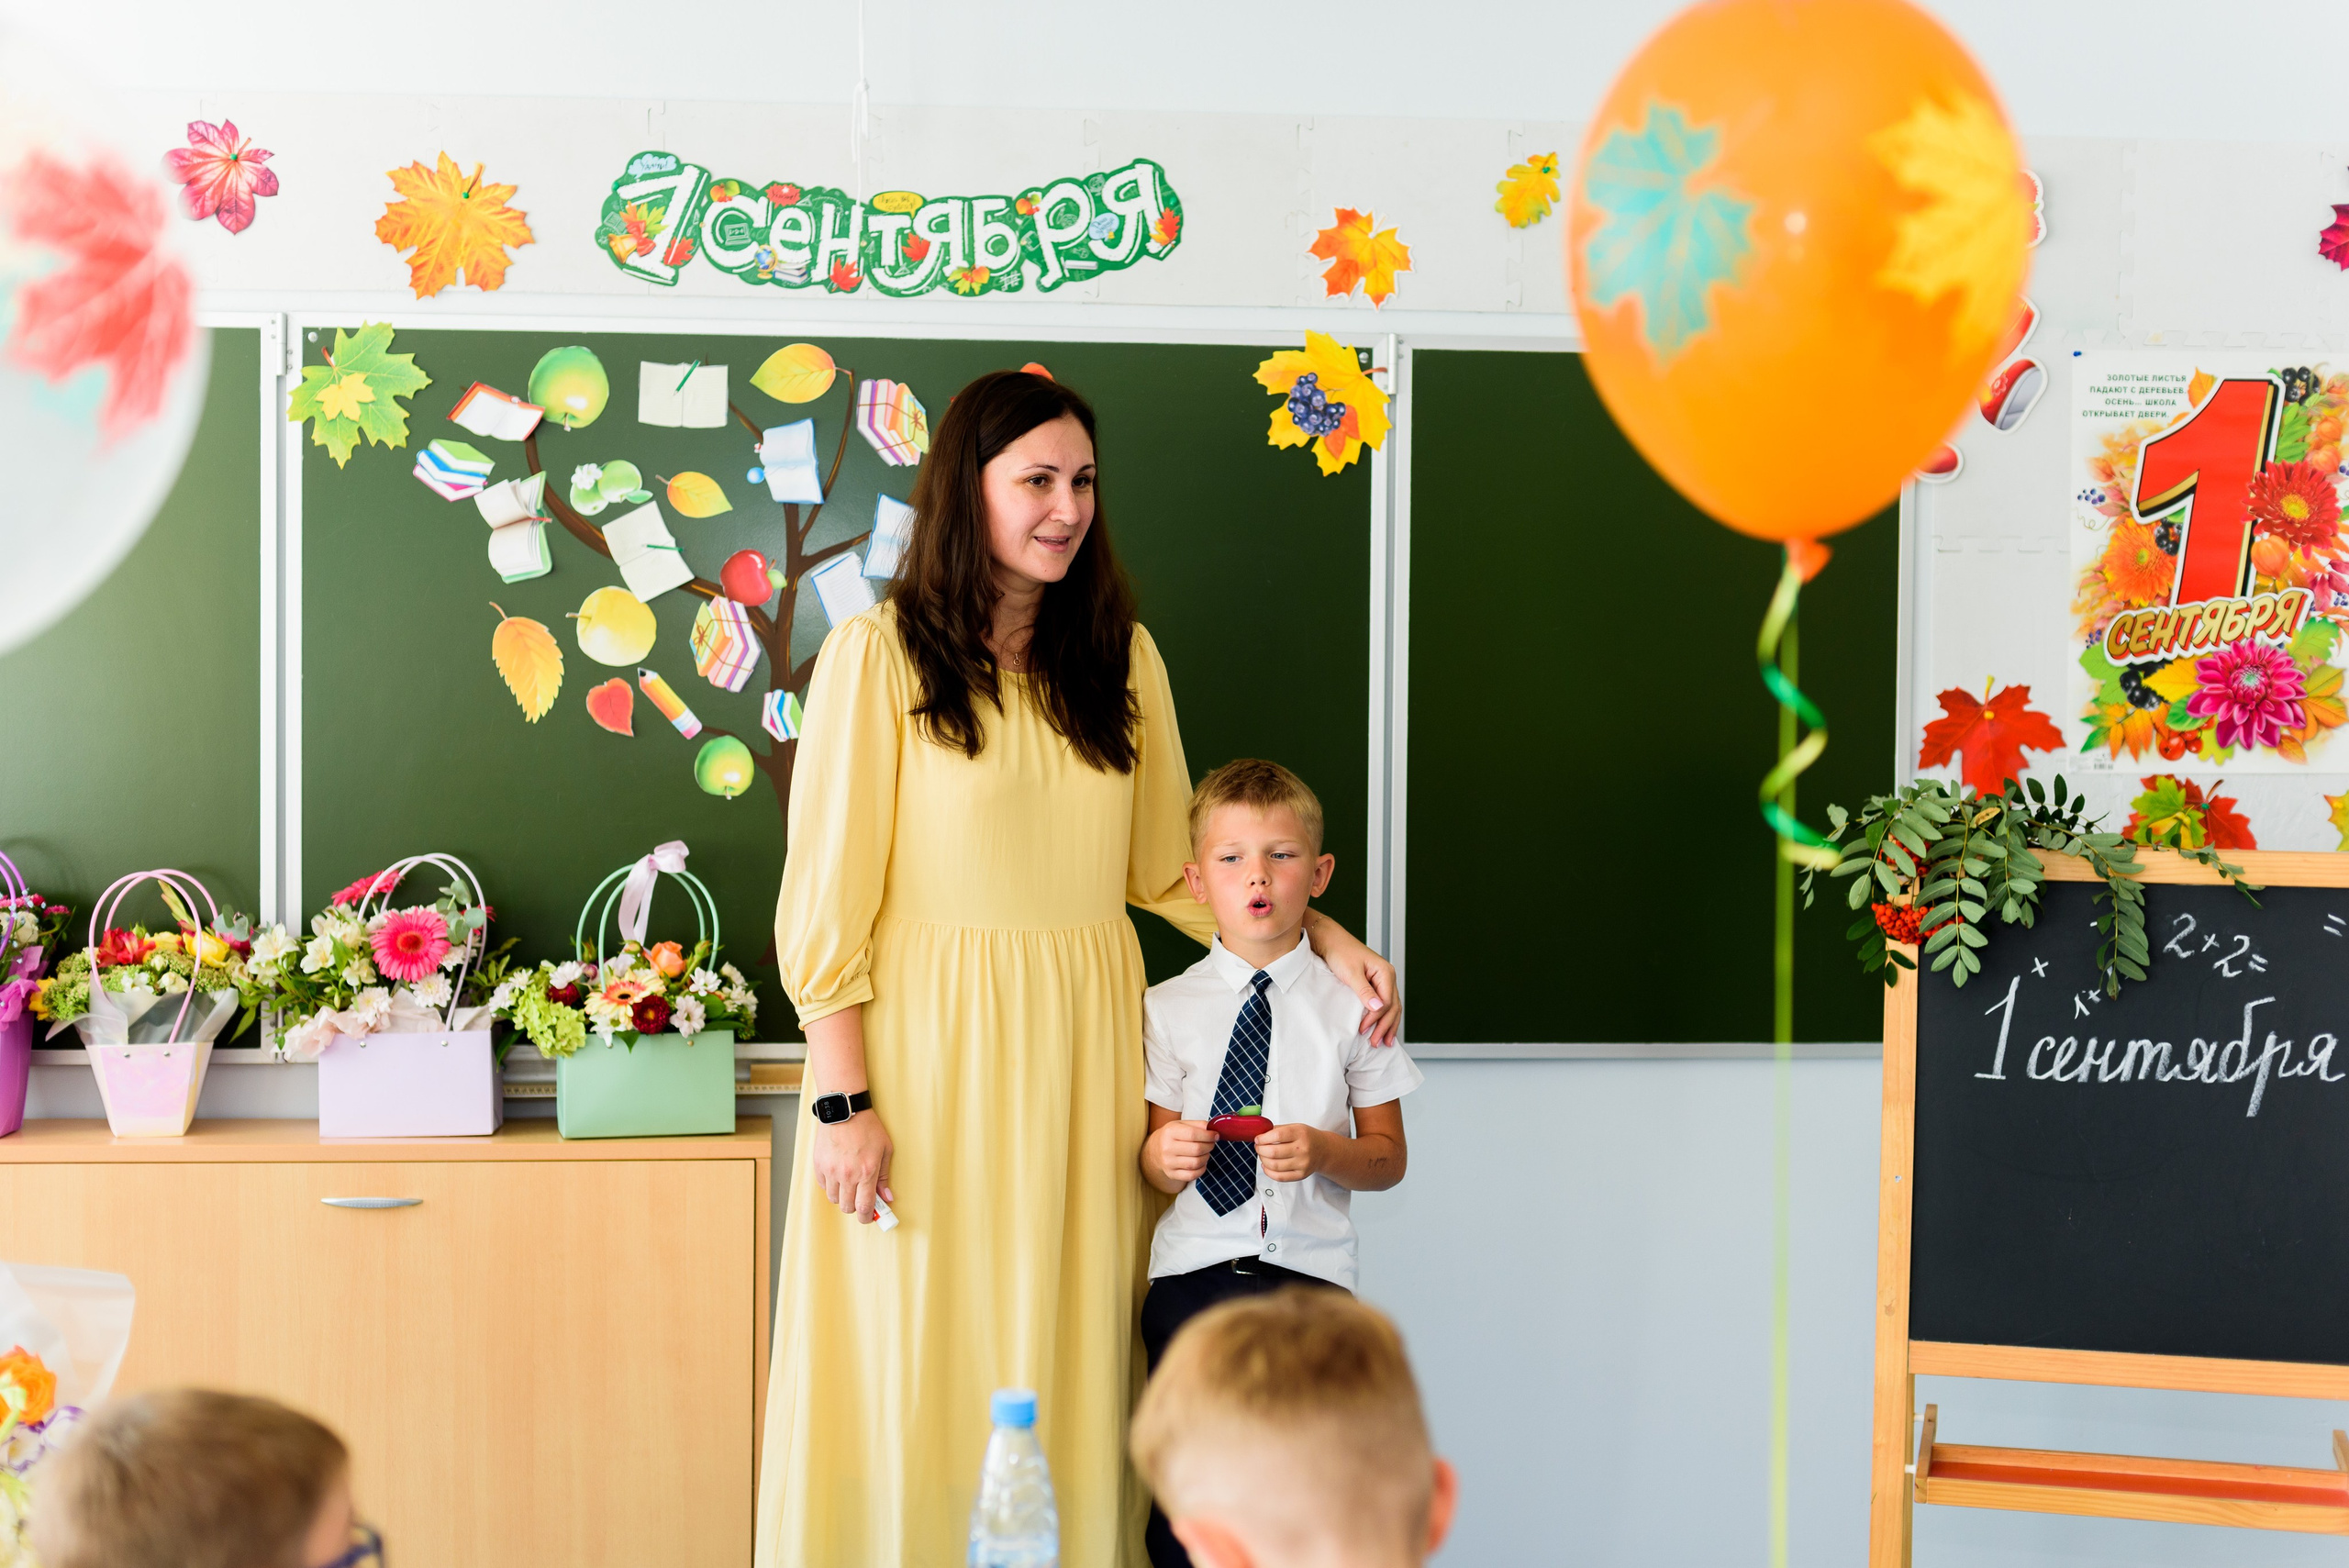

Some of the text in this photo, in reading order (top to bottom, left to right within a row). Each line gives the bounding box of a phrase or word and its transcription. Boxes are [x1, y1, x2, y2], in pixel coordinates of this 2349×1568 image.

[2089, 385, 2128, 394] ПАДАЮТ
[2139, 386, 2187, 395] ДЕРЕВЬЕВ.
[2107, 373, 2187, 382] ЗОЛОТЫЕ ЛИСТЬЯ
[2082, 409, 2170, 419] ОТКРЫВАЕТ ДВЕРИ.
[2137, 378, 2276, 606] 1
[2107, 590, 2309, 661] СЕНТЯБРЯ
[1974, 975, 2347, 1118] 1 сентября
